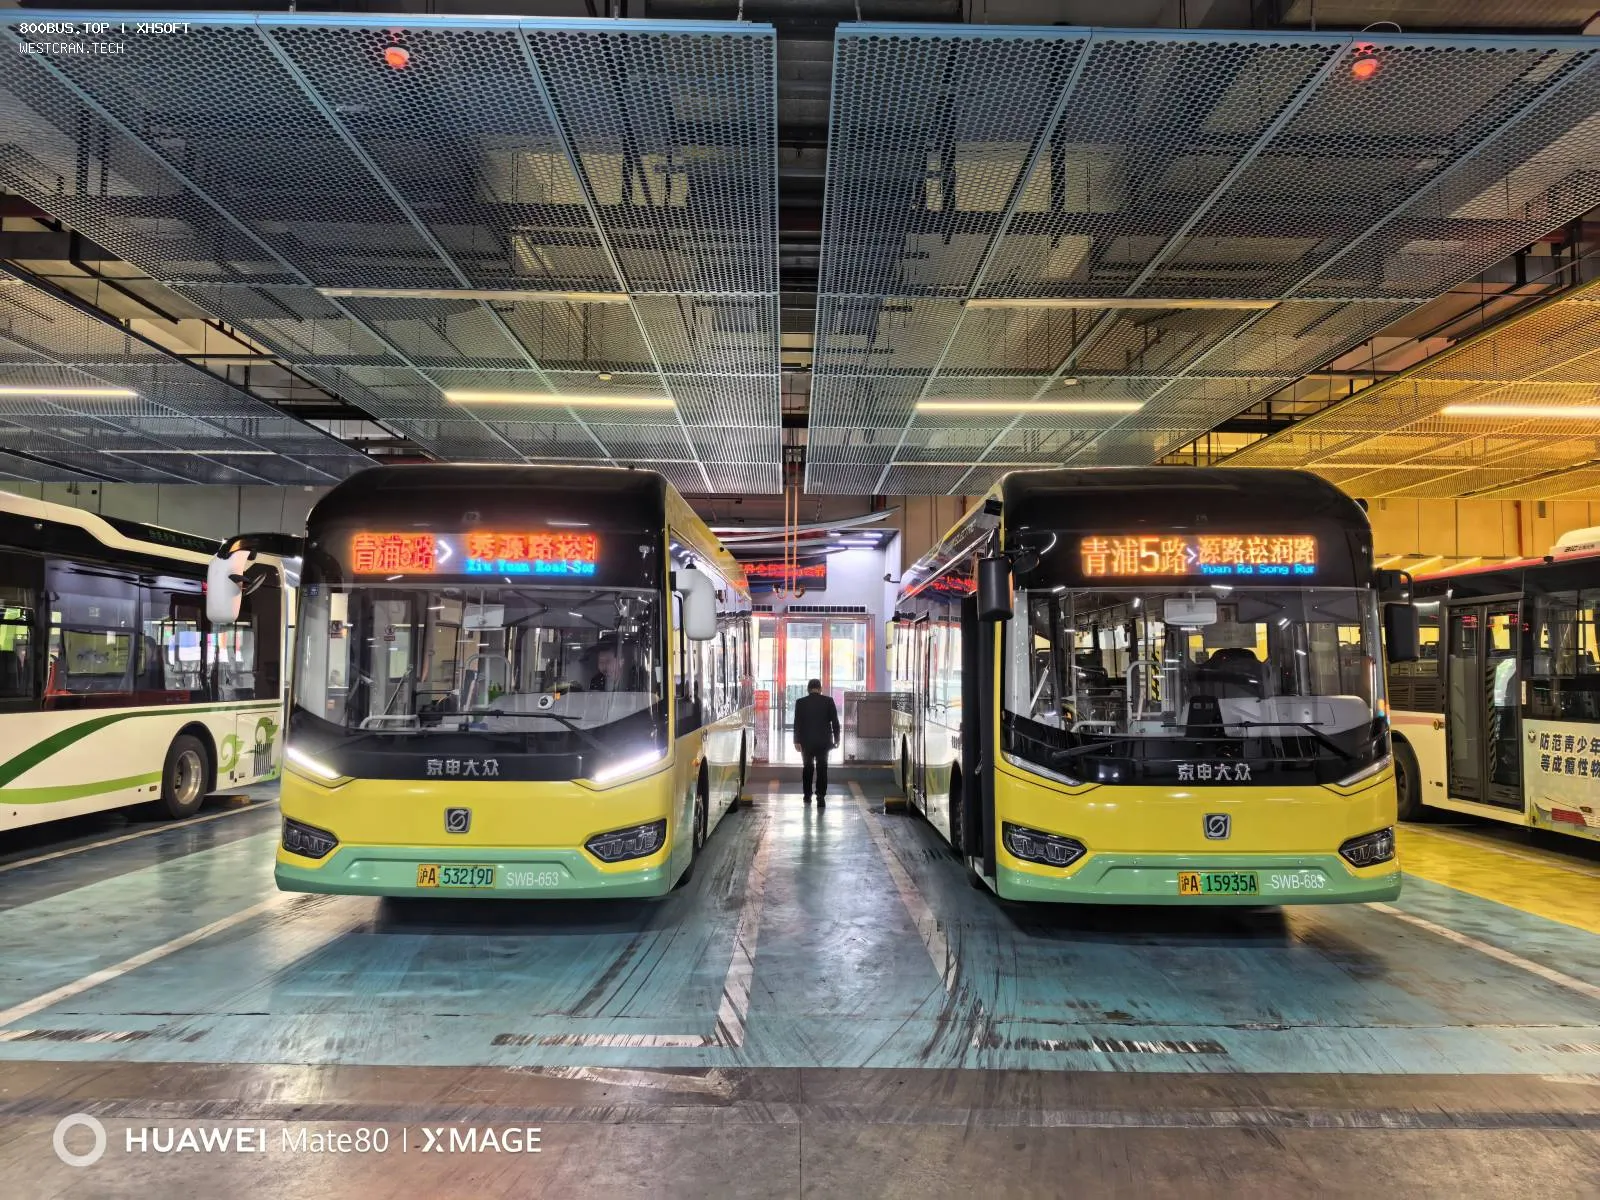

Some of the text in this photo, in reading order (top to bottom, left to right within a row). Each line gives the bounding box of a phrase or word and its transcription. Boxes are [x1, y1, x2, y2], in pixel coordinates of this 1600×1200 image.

[1082, 536, 1187, 575] 青浦5路
[1201, 564, 1232, 574] Yuan
[1258, 564, 1290, 575] Song
[426, 758, 500, 776] 京申大众
[1177, 763, 1252, 781] 京申大众
[506, 871, 560, 887] SWB-653
